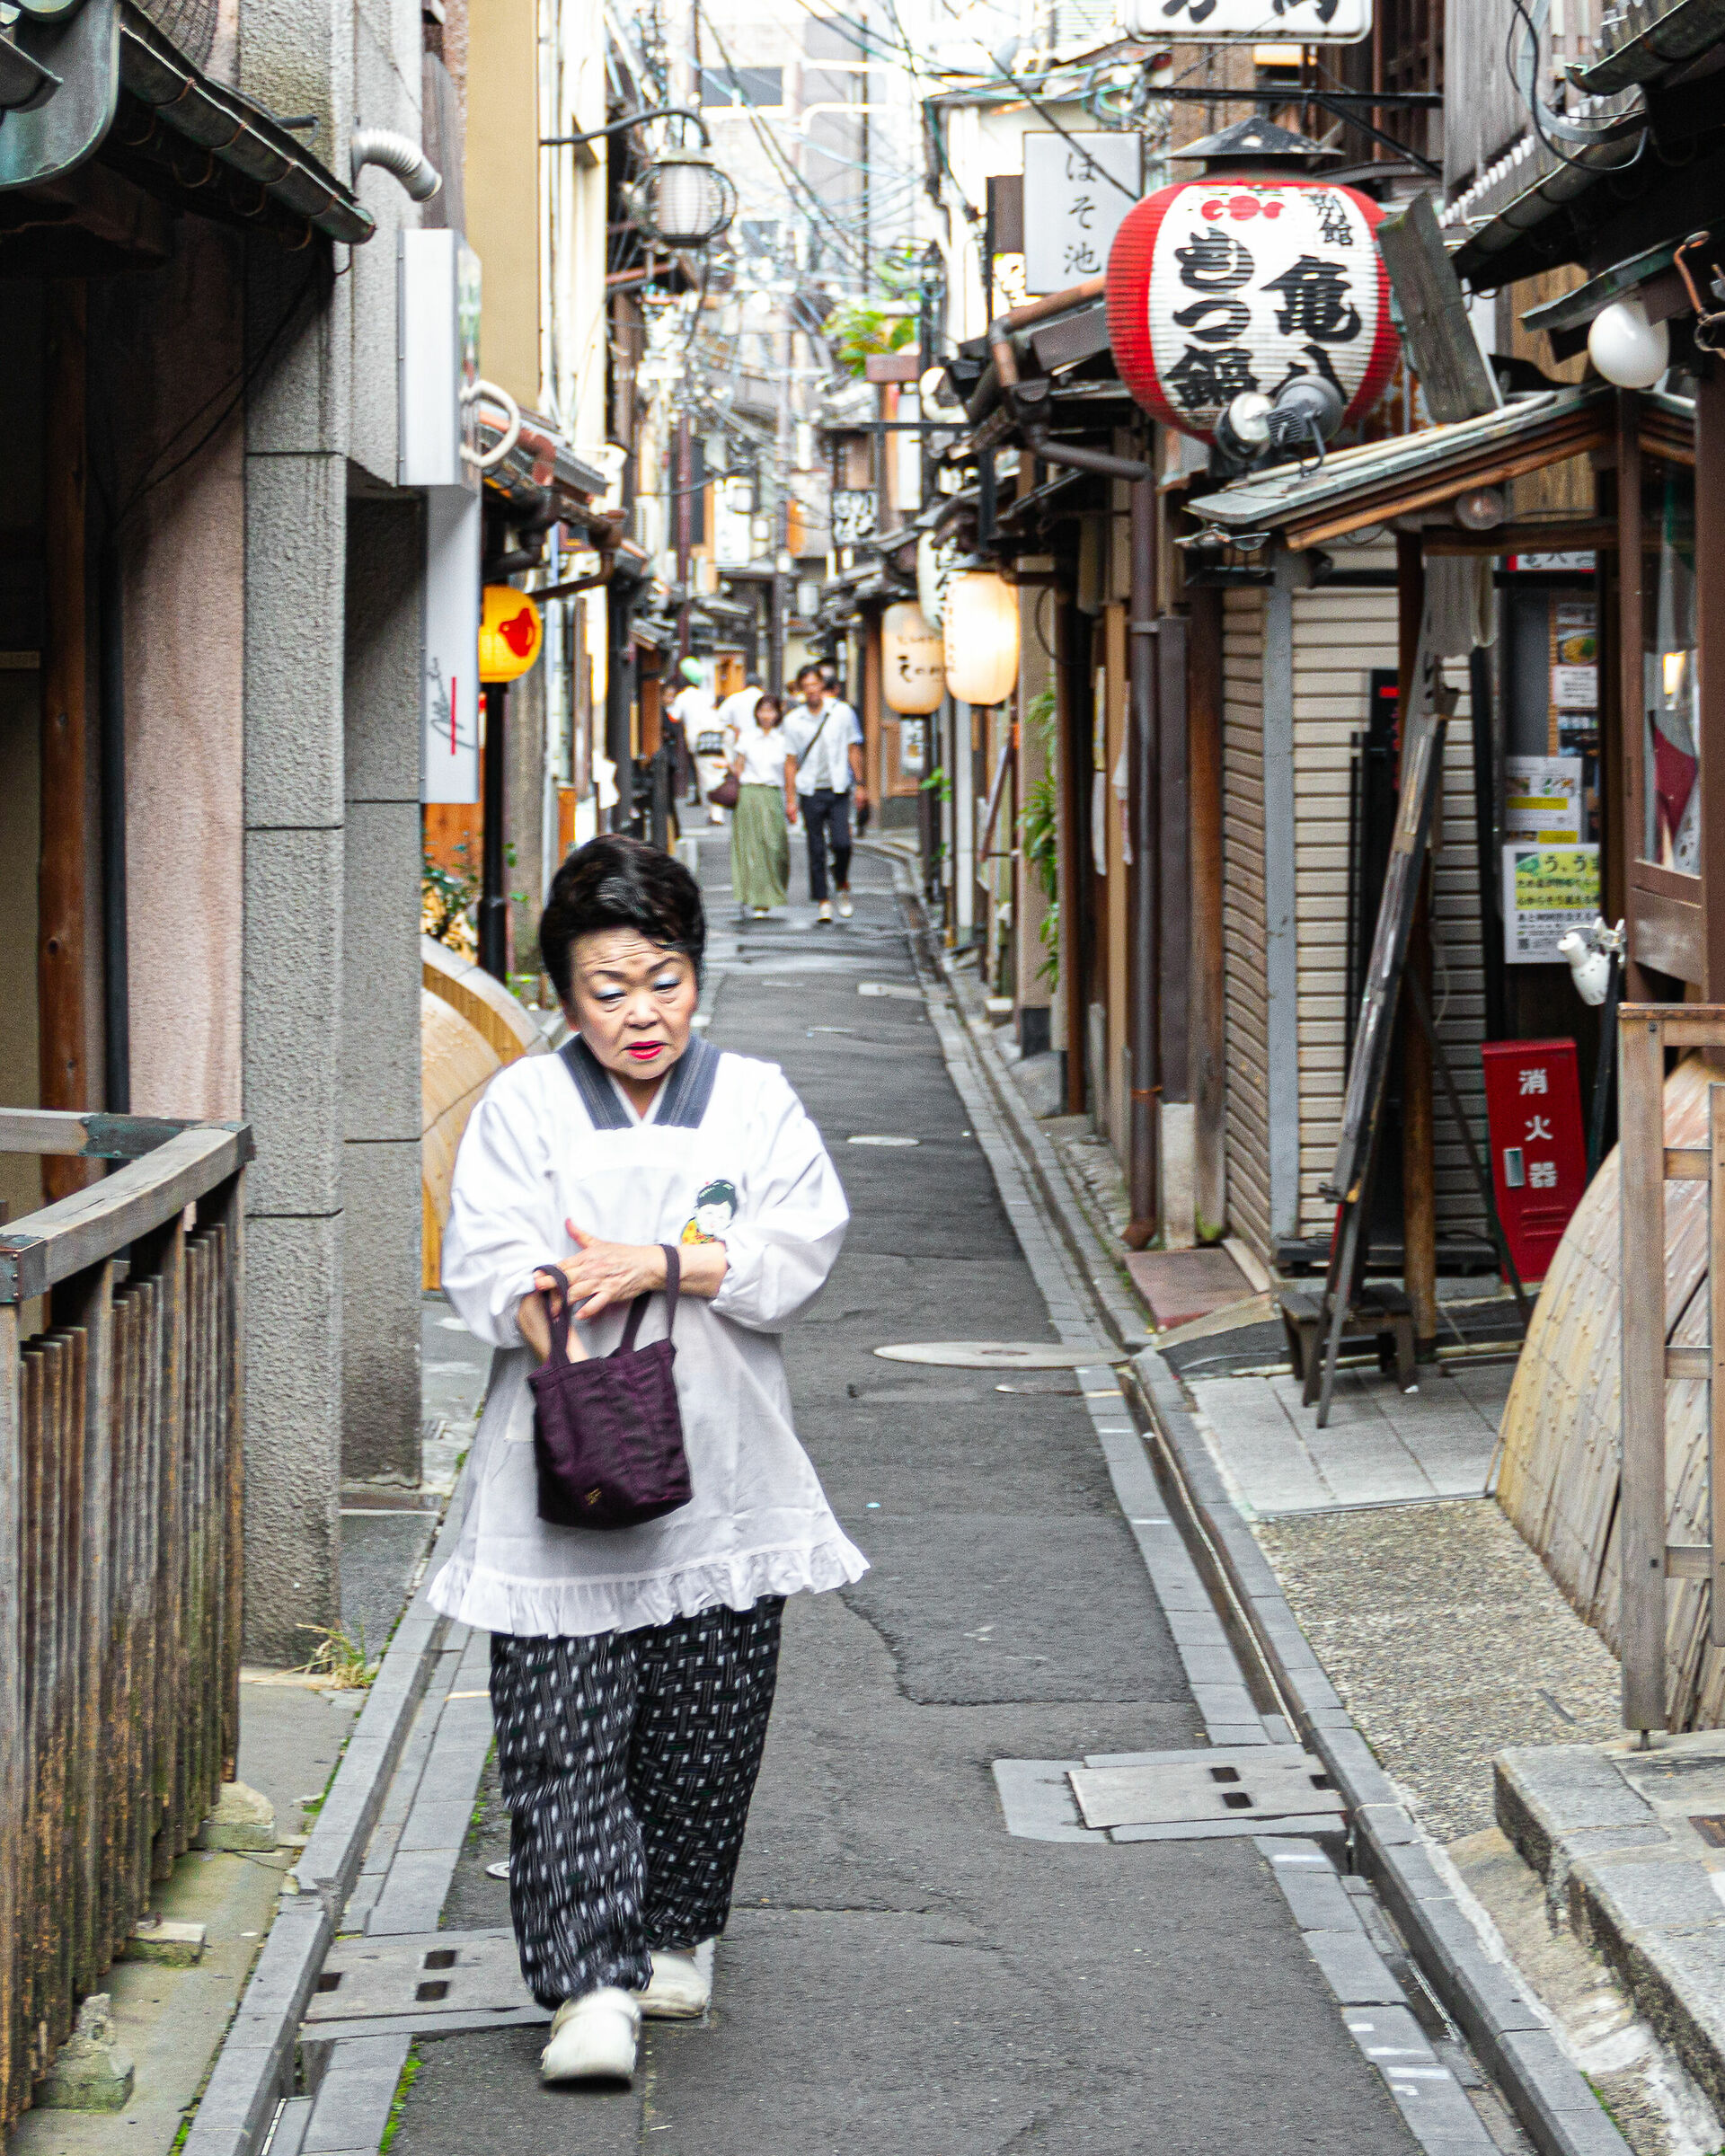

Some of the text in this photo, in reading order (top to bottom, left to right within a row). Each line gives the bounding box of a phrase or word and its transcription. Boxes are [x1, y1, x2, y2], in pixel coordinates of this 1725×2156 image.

[1065, 152, 1101, 275] ほそ池
[1163, 226, 1261, 408] もつ鍋
[1260, 254, 1362, 405] 亀八
[1517, 1068, 1559, 1189] 消火器
